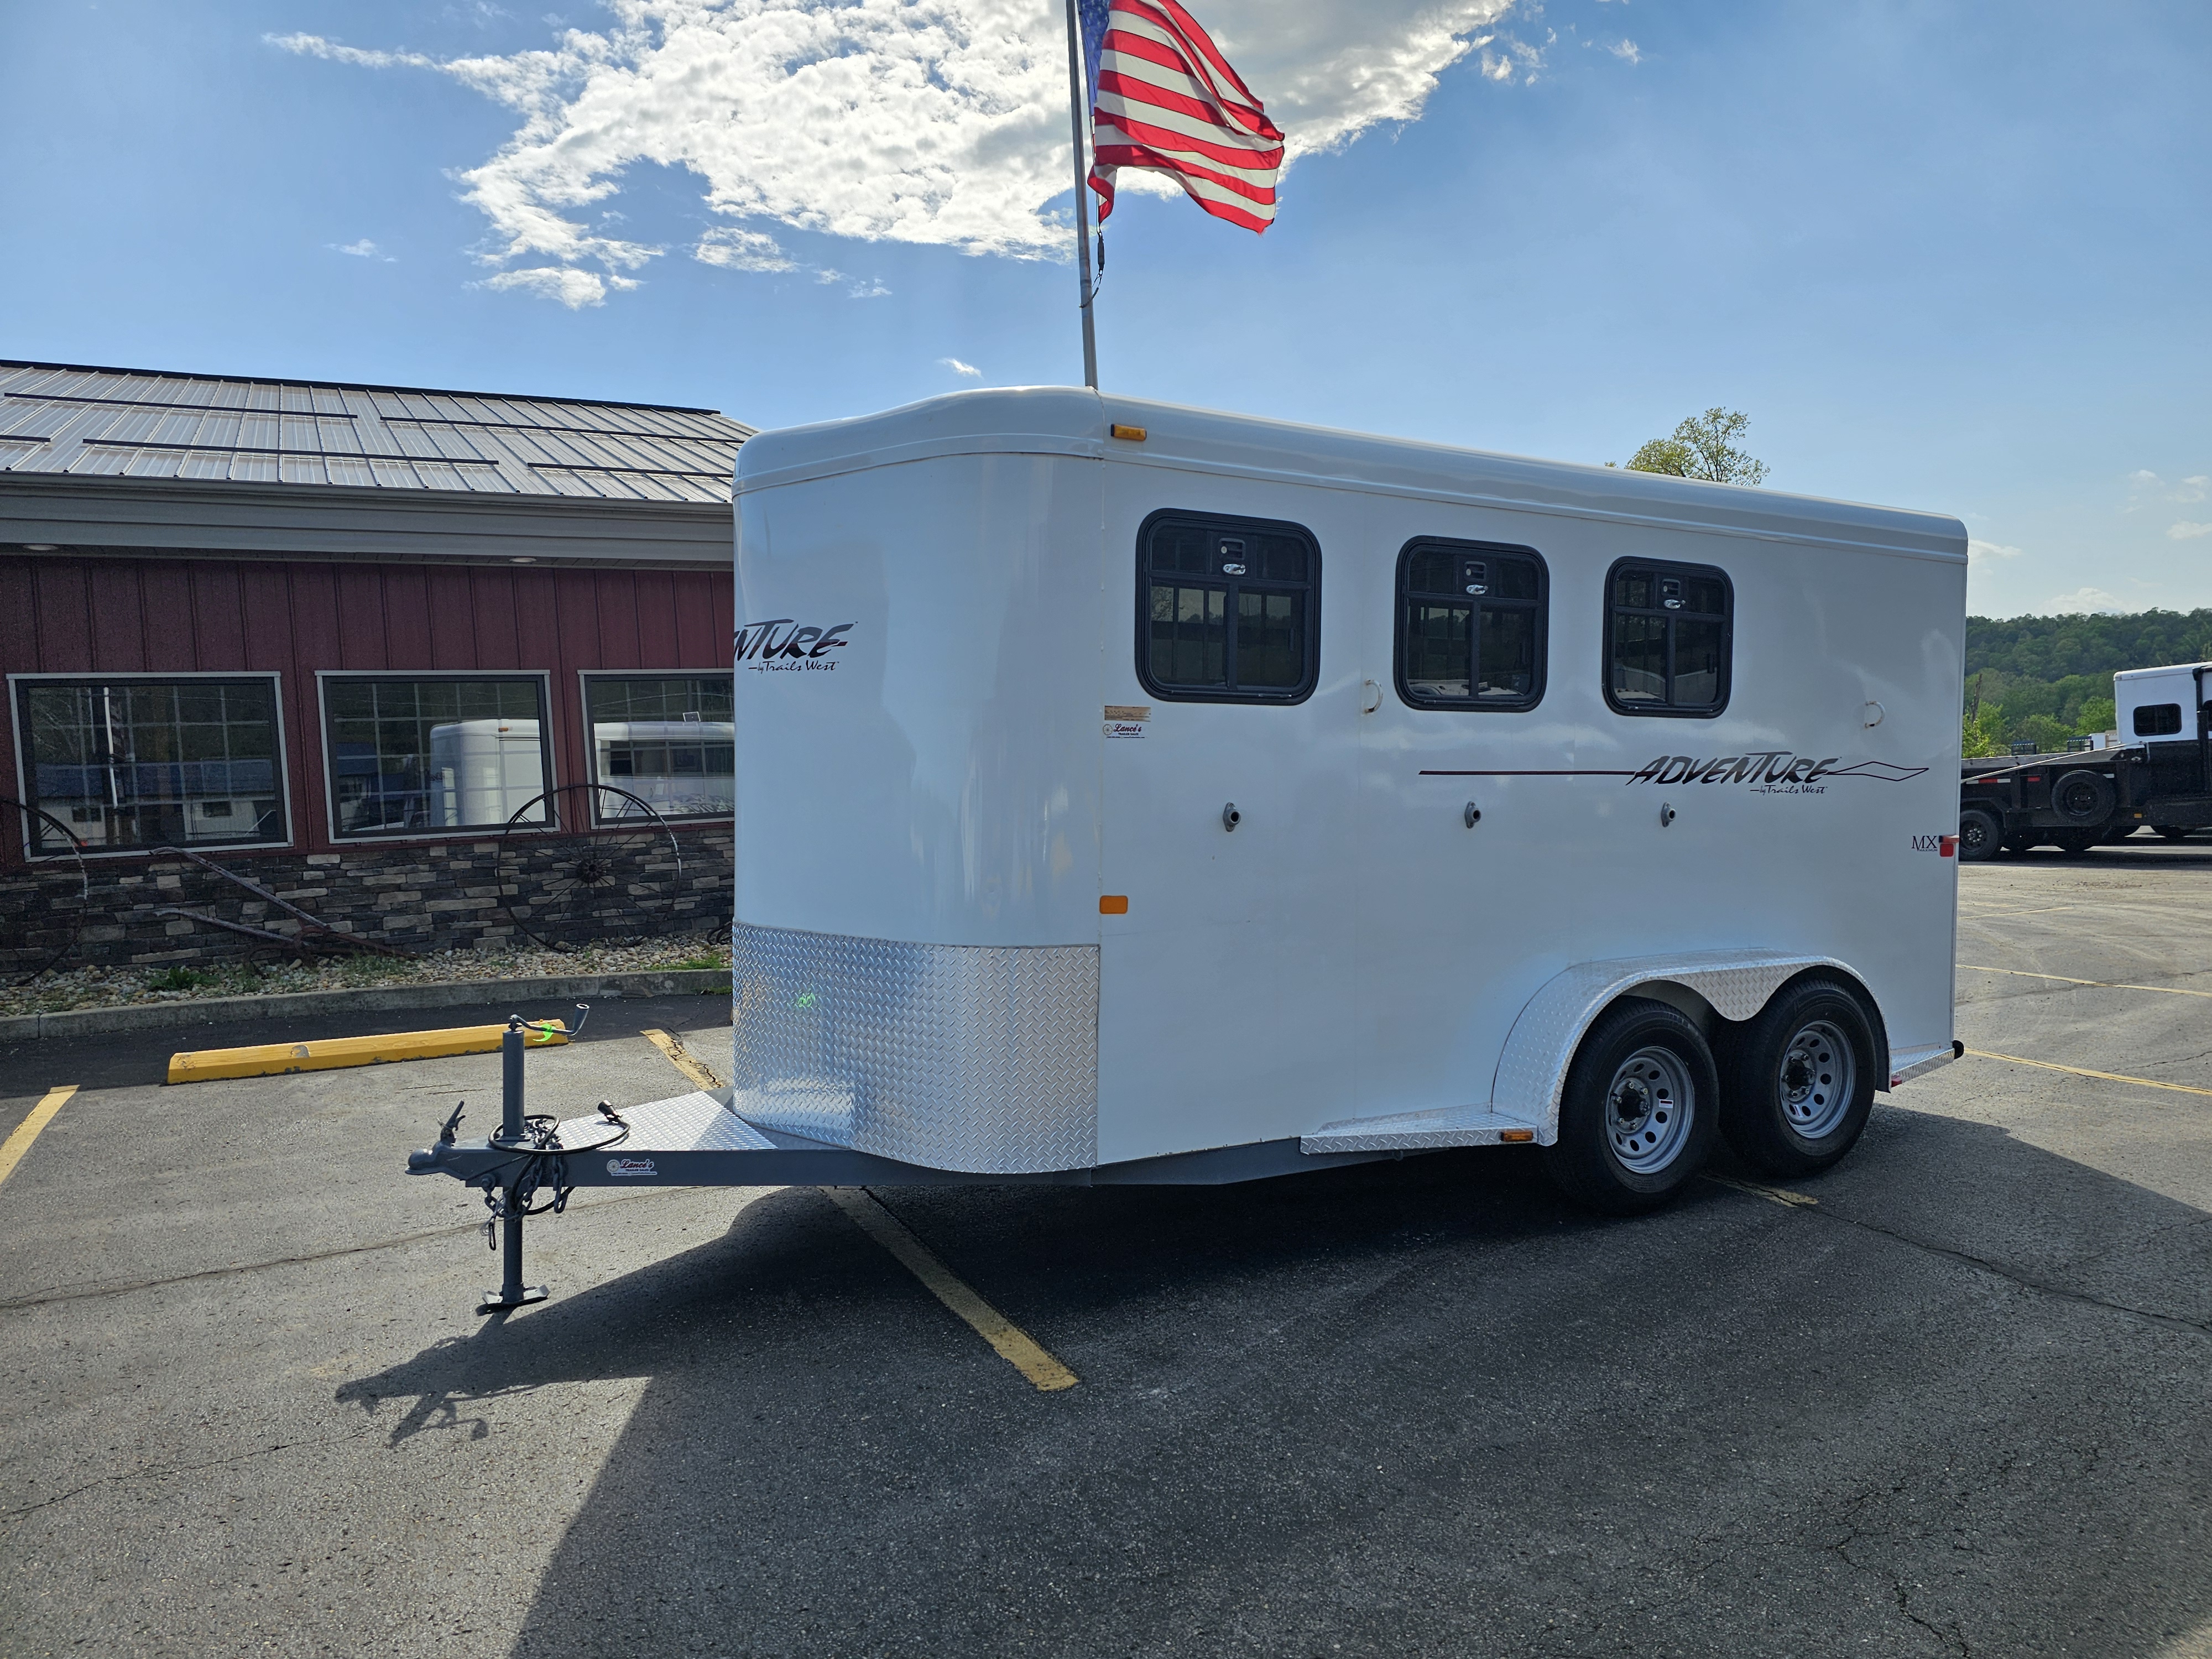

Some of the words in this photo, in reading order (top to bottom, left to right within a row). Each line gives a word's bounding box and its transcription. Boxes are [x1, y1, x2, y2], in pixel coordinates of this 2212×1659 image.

[763, 660, 801, 671] Trails
[806, 660, 836, 671] West
[1113, 723, 1141, 732] Lance's
[1625, 751, 1839, 786] ADVENTURE
[1764, 785, 1798, 794] Trails
[1802, 785, 1825, 794] West
[1911, 836, 1937, 851] MX
[620, 1160, 653, 1168] Lance's
